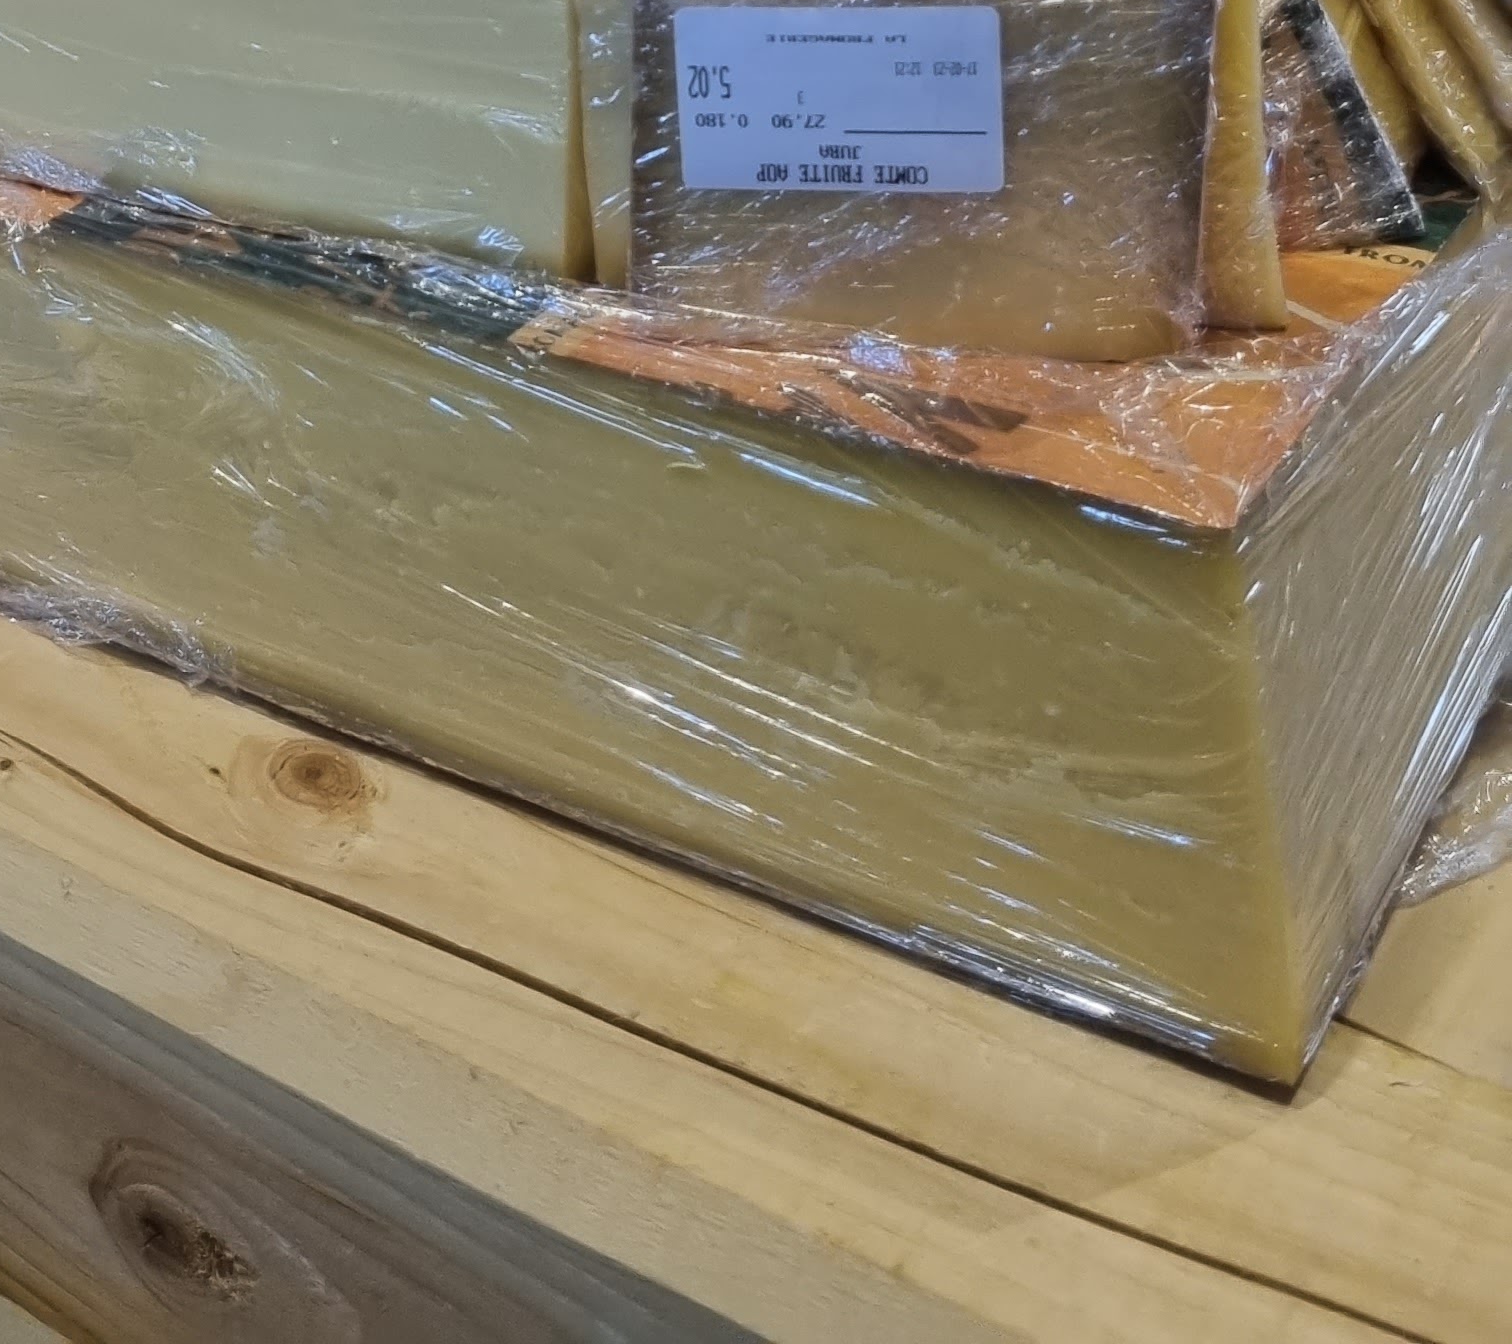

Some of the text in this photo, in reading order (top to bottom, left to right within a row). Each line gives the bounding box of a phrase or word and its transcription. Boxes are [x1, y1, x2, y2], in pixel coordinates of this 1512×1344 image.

[766, 33, 874, 44] FROMAGERIE
[688, 65, 731, 99] 5.02
[695, 113, 826, 129] 27.90 0.180
[818, 144, 862, 160] JURA
[756, 163, 929, 185] COMTE FRUITE AOP
